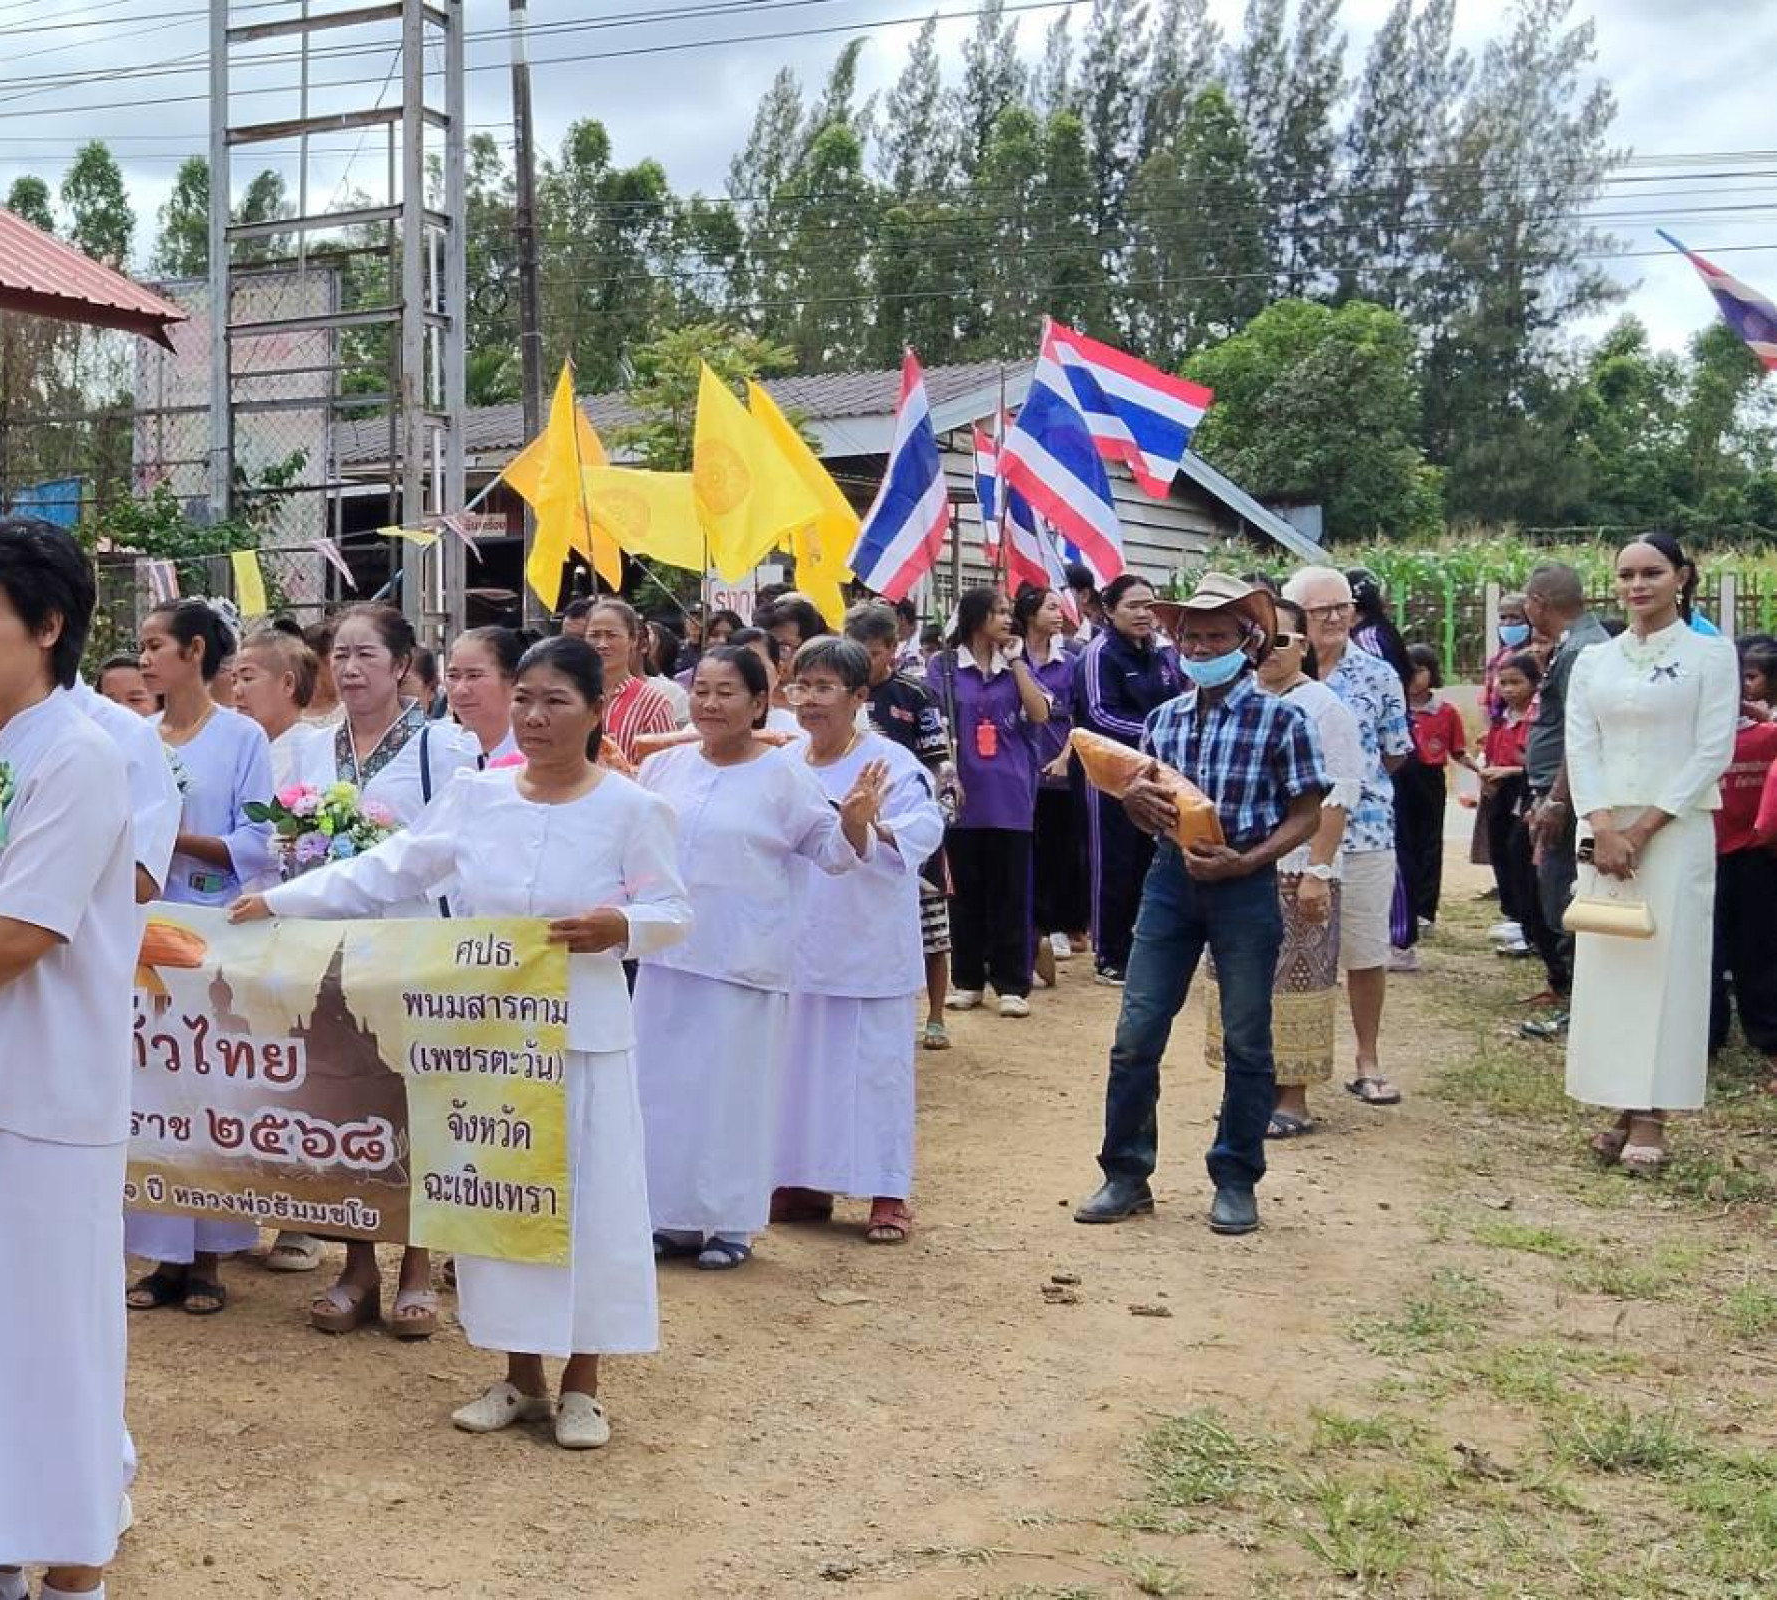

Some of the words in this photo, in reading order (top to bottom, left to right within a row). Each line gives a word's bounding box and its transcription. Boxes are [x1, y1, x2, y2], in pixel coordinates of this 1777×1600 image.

[455, 934, 521, 967] ศปธ.
[402, 989, 568, 1025] พนมสารคาม
[410, 1040, 564, 1084] (เพชรตะวัน)
[206, 1107, 388, 1164] ๒๕๖๘
[446, 1099, 532, 1150] จังหวัด
[146, 1176, 164, 1201] ปี
[174, 1186, 379, 1230] หลวงพ่อธัมมชโย
[423, 1164, 557, 1216] ฉะเชิงเทรา
